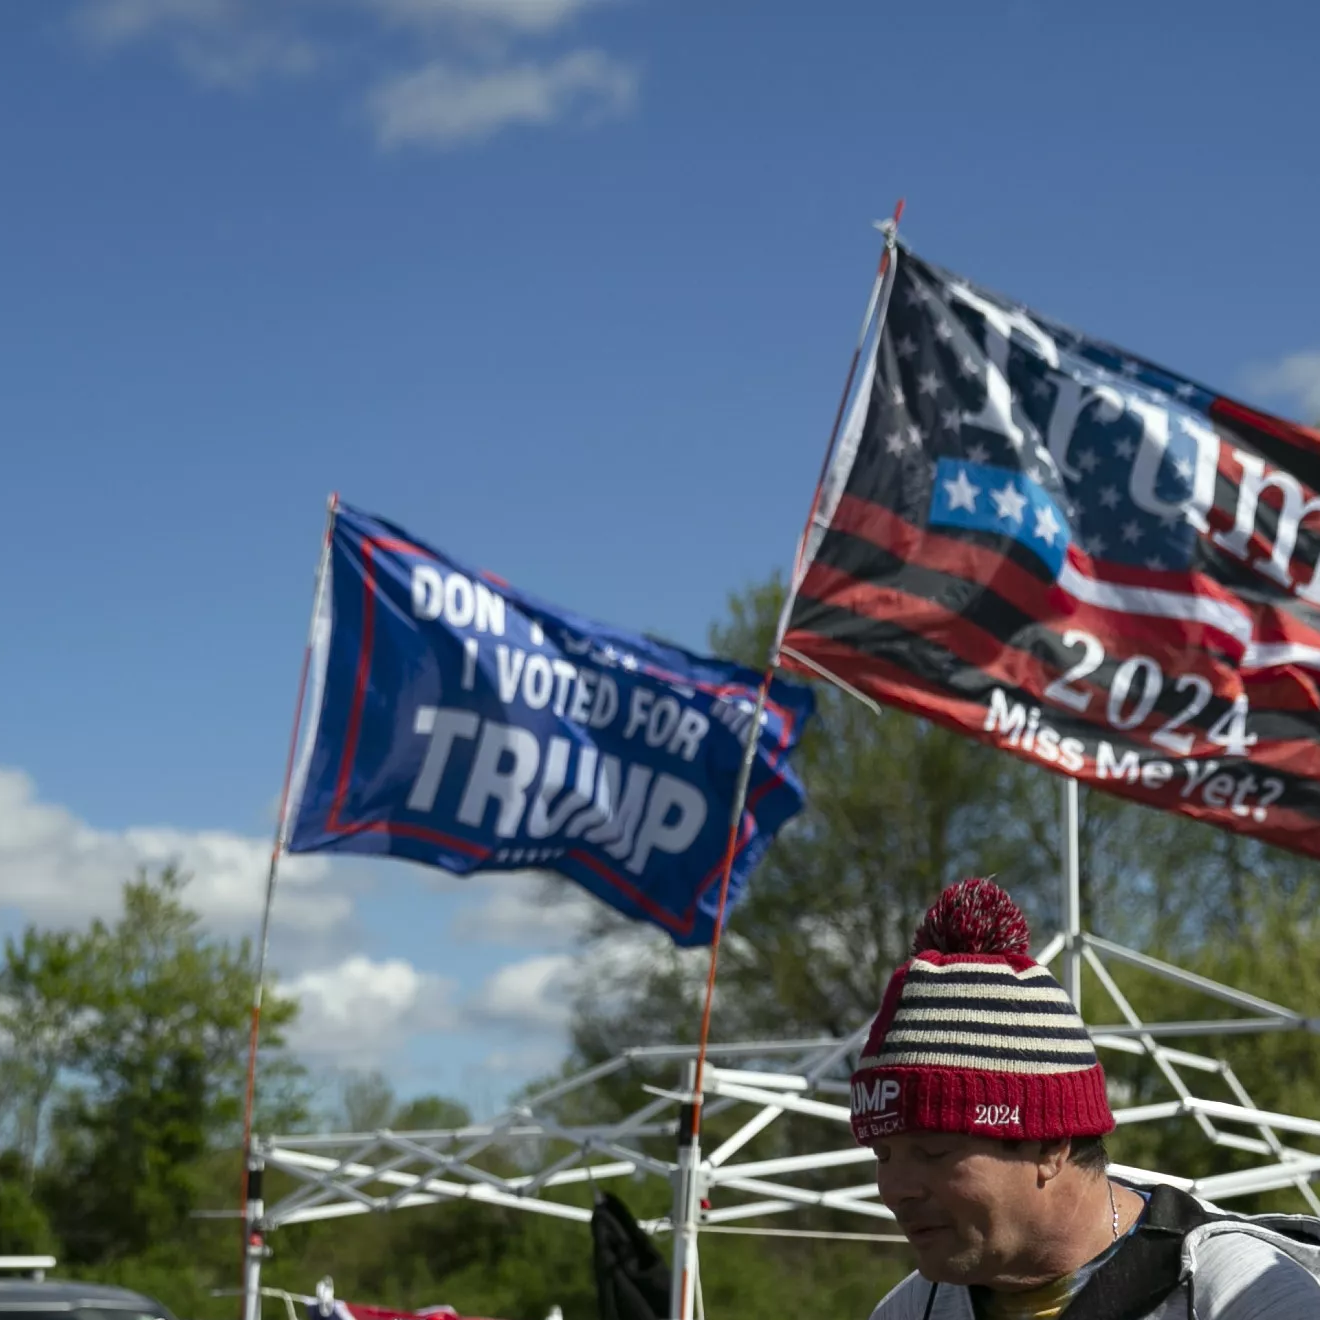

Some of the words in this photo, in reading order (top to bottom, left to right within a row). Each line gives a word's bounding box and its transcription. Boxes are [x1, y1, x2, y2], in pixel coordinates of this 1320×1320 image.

[461, 637, 480, 692] I
[495, 644, 618, 729] VOTED
[622, 687, 711, 763] FOR
[984, 686, 1085, 775] Miss
[1095, 738, 1173, 790] Me
[1183, 757, 1285, 823] Yet?
[1043, 628, 1259, 758] 2024
[406, 704, 709, 876] TRUMP
[974, 1103, 1021, 1126] 2024
